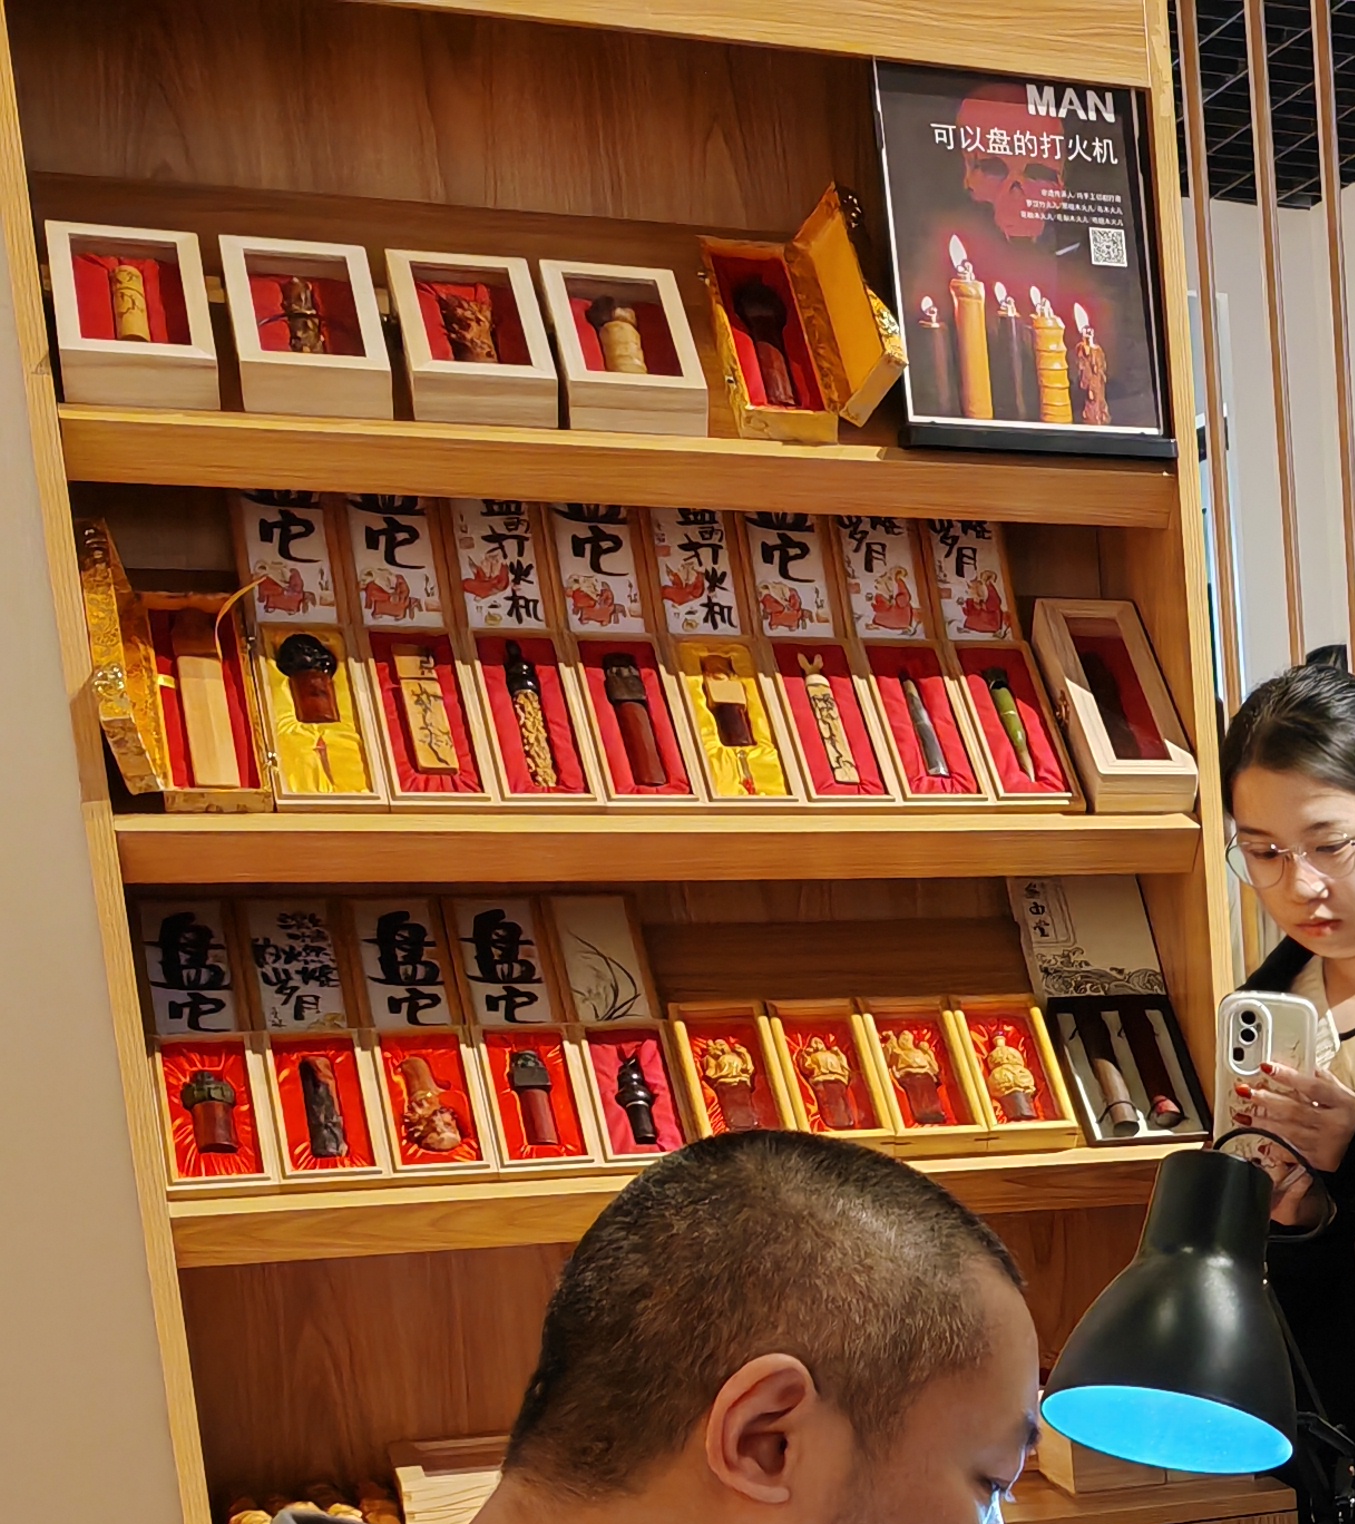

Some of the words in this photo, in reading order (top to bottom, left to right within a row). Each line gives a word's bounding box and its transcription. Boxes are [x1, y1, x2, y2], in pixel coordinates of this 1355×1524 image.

[1025, 84, 1116, 122] MAN
[930, 122, 1118, 165] 可以盘的打火机
